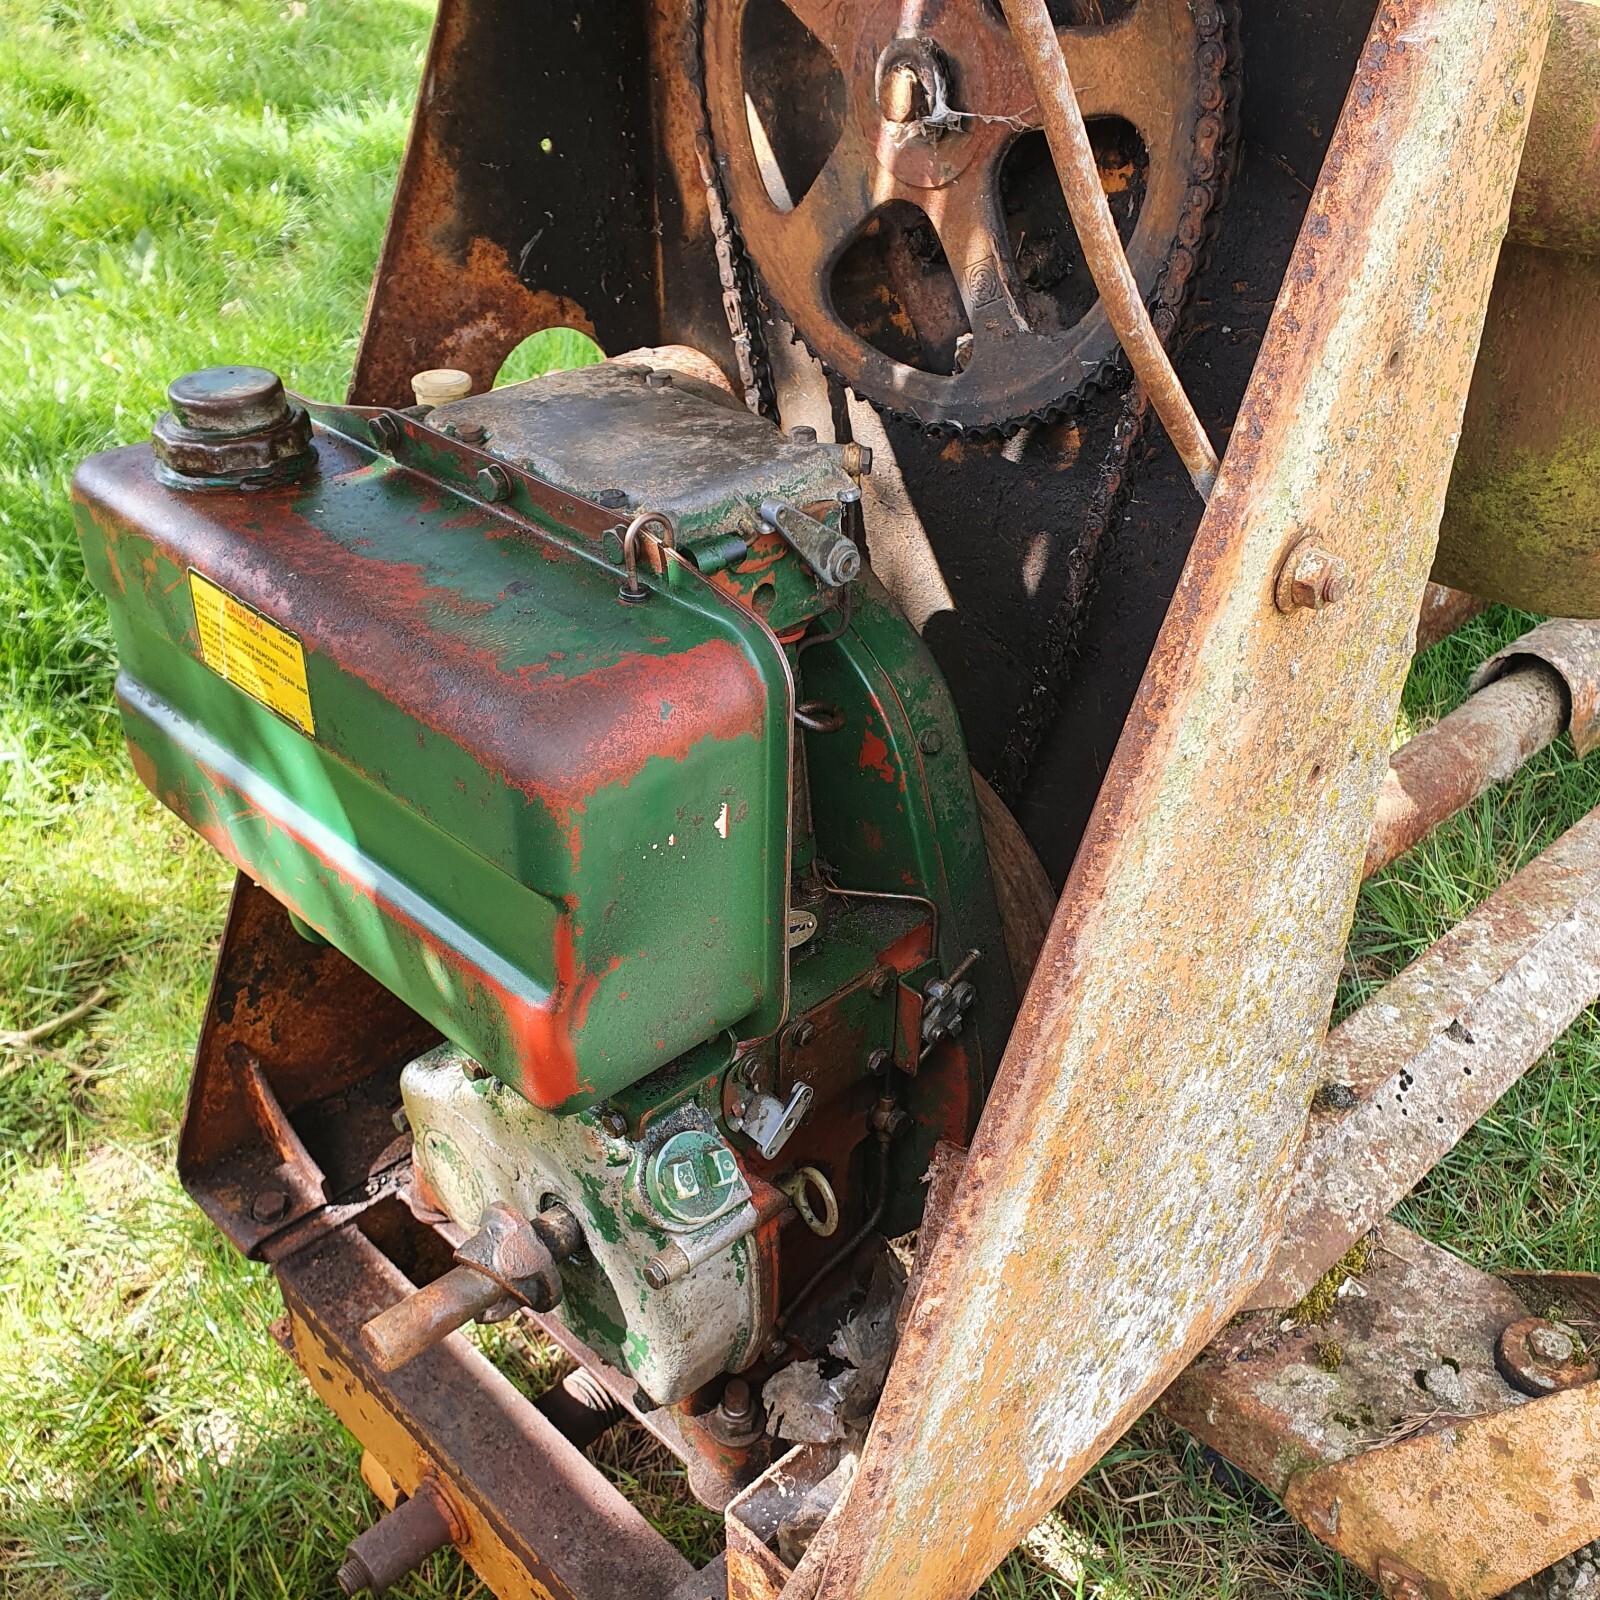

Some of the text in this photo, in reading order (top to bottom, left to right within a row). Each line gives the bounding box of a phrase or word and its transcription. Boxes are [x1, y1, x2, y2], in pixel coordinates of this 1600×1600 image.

[224, 599, 264, 633] CAUTION
[268, 639, 296, 662] ELECTRICAL
[278, 671, 295, 687] CLEAN
